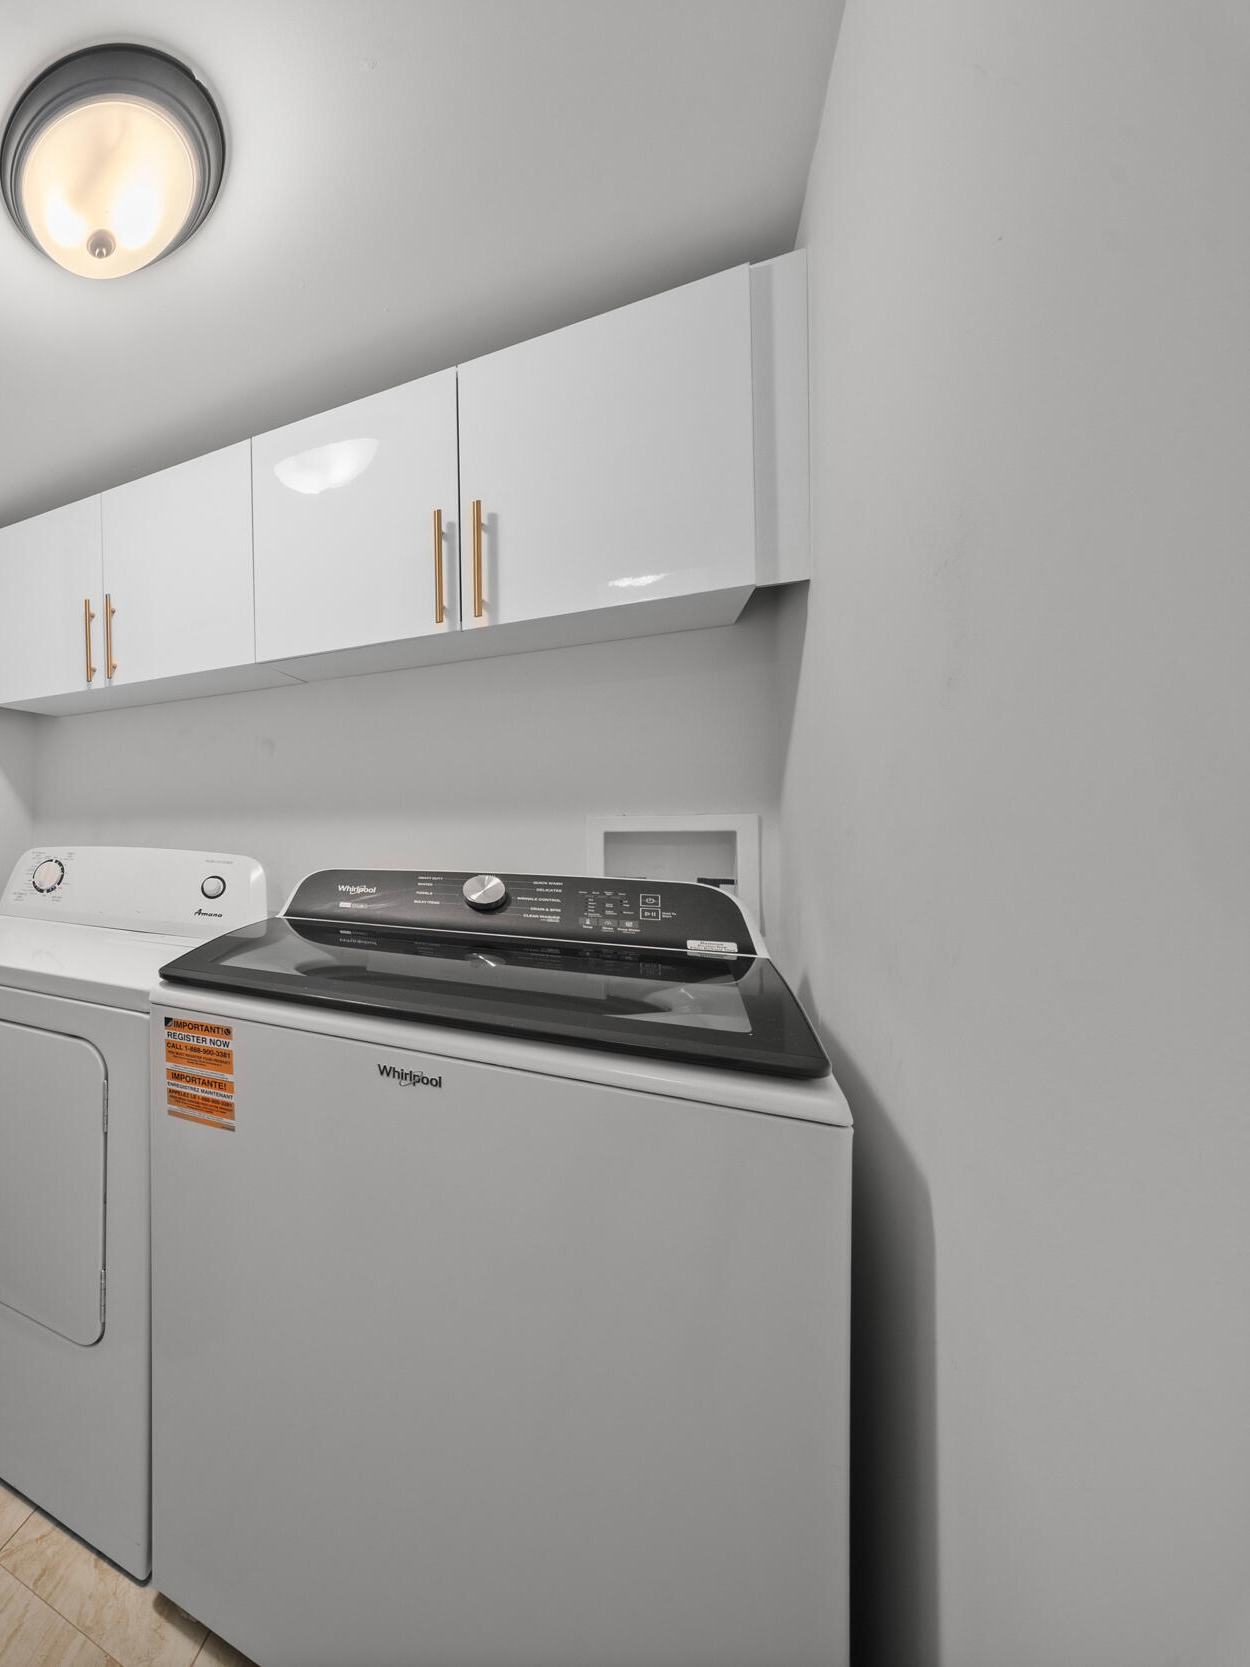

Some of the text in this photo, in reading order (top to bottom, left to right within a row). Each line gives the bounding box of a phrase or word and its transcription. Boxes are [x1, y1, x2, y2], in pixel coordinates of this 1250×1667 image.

[338, 885, 377, 895] Whirlpool
[193, 908, 223, 918] Amana
[173, 1020, 224, 1035] IMPORTANT!
[166, 1042, 183, 1050] CALL
[167, 1031, 230, 1049] REGISTER NOW
[171, 1072, 227, 1091] IMPORTANTE!
[377, 1063, 442, 1089] Whirlpool
